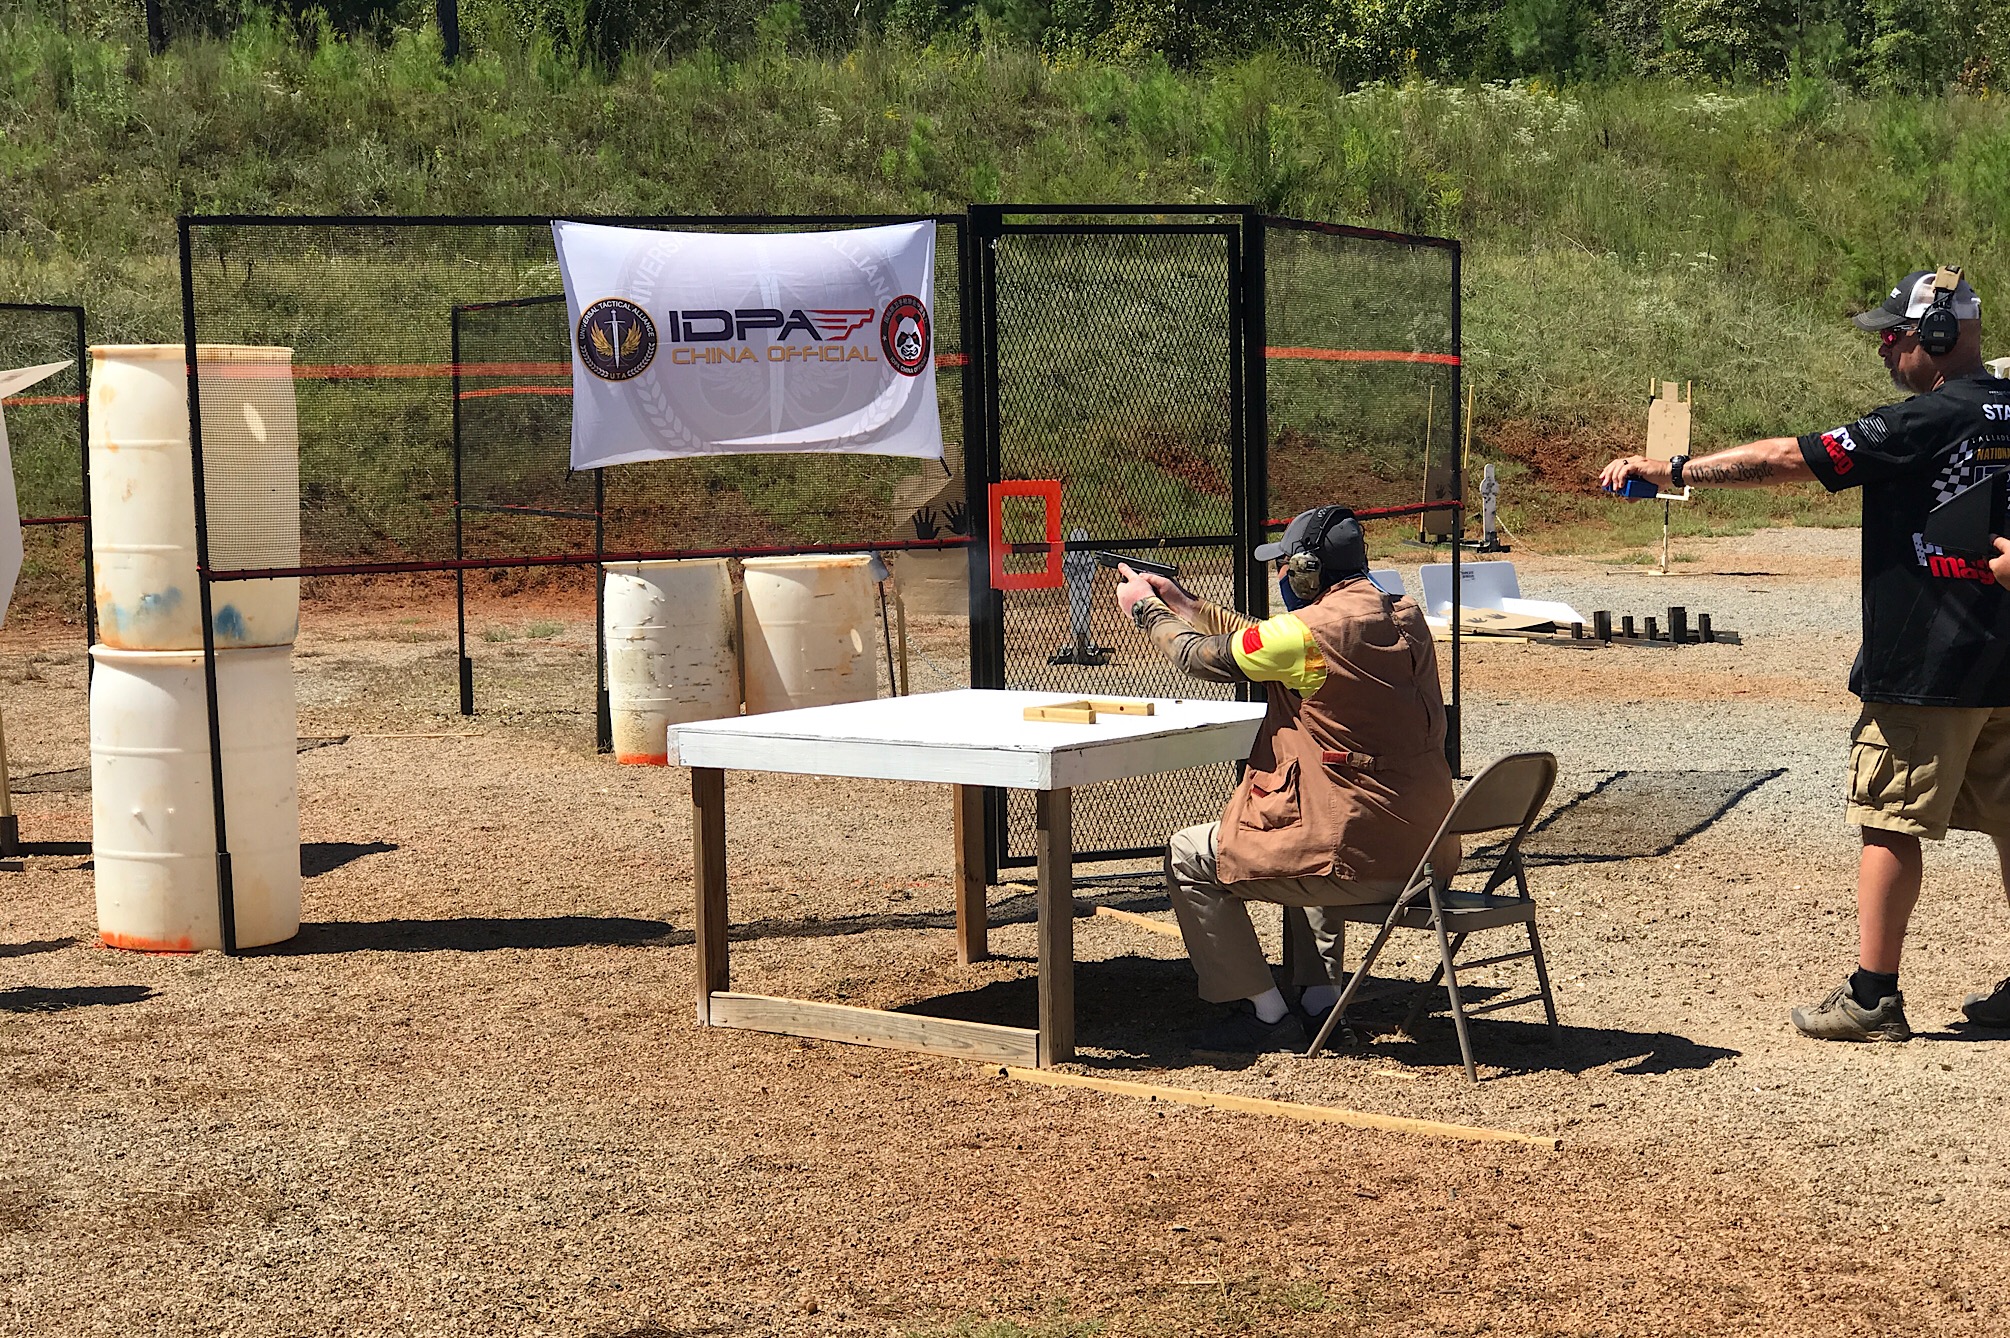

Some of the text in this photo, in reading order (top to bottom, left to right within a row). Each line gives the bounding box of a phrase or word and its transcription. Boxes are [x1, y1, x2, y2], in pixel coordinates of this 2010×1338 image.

[580, 300, 655, 340] UNIVERSAL TACTICAL ALLIANCE
[669, 308, 822, 342] IDPA
[671, 345, 878, 365] CHINA OFFICIAL
[1731, 460, 1774, 484] People
